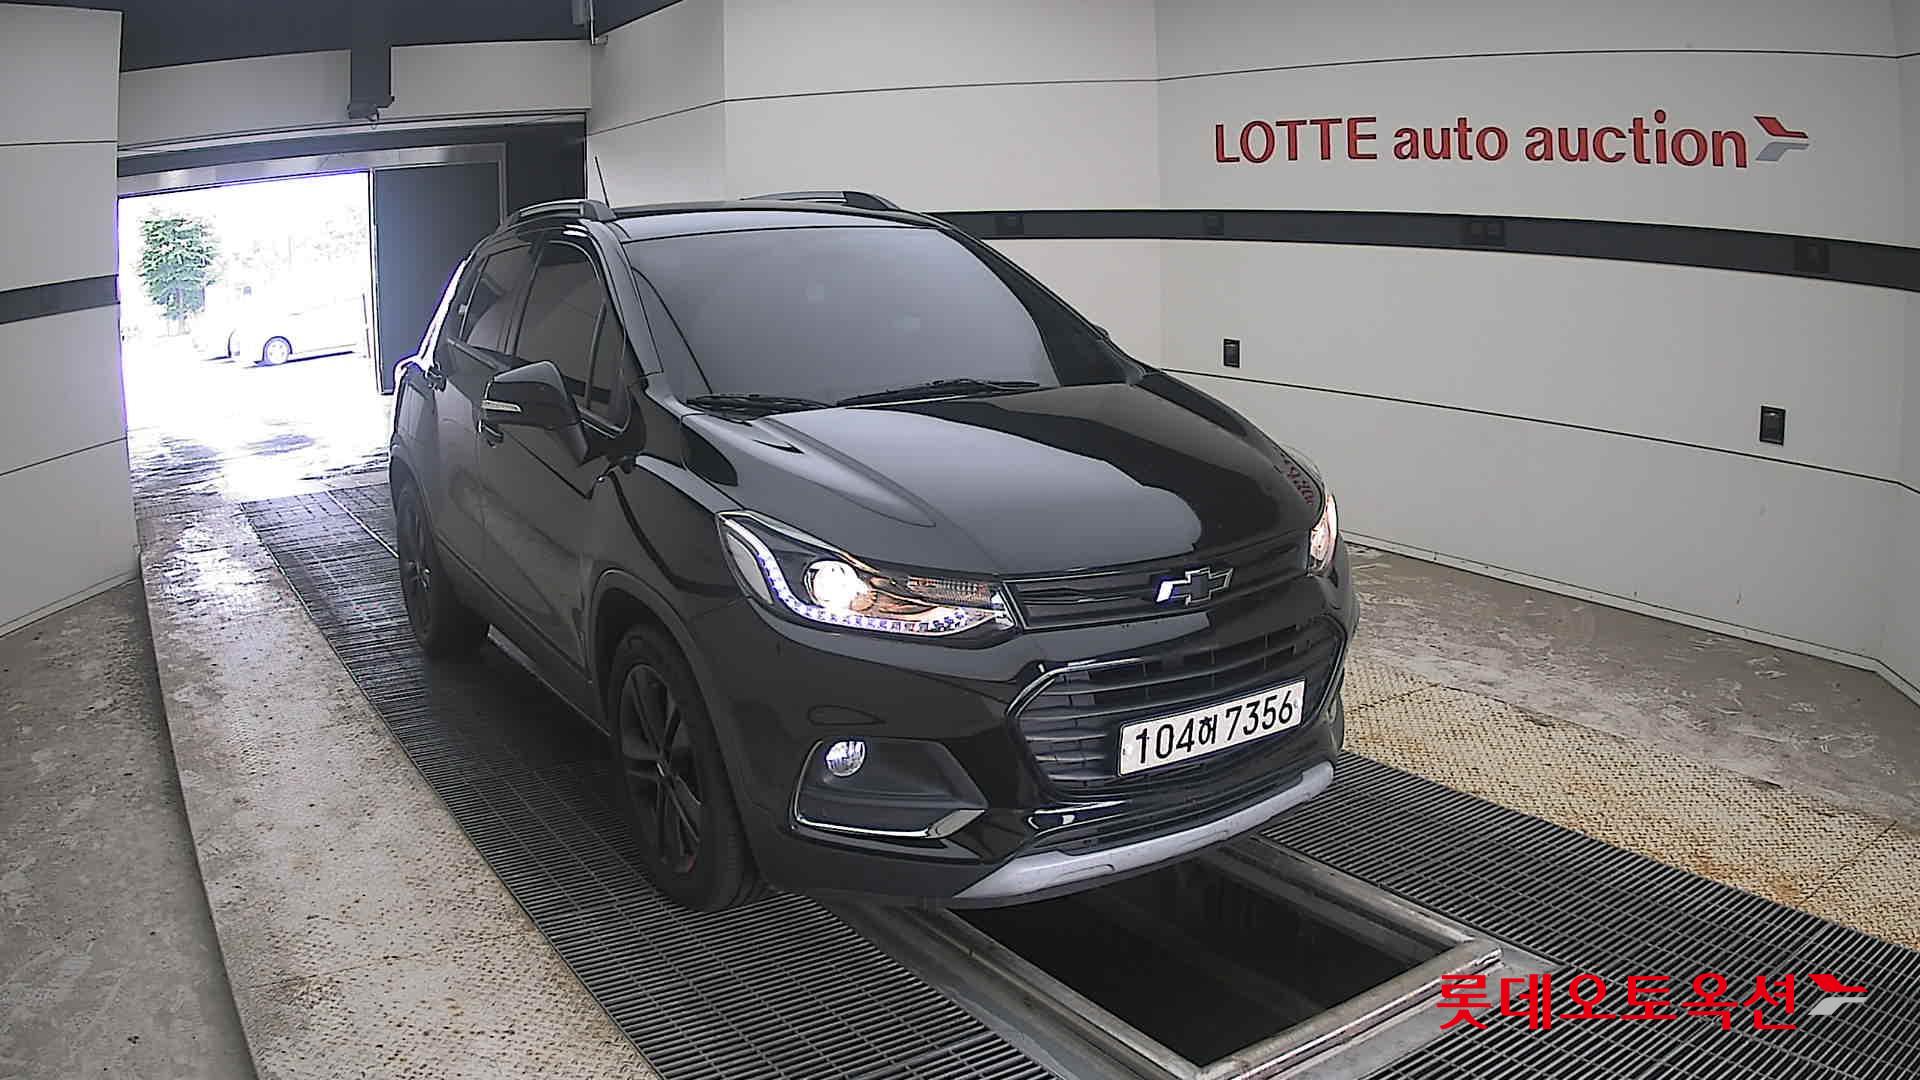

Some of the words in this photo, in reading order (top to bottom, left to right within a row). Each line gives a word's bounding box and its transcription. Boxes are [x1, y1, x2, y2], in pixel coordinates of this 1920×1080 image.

[1215, 117, 1377, 164] LOTTE
[1392, 117, 1508, 162] auto
[1524, 110, 1748, 168] auction
